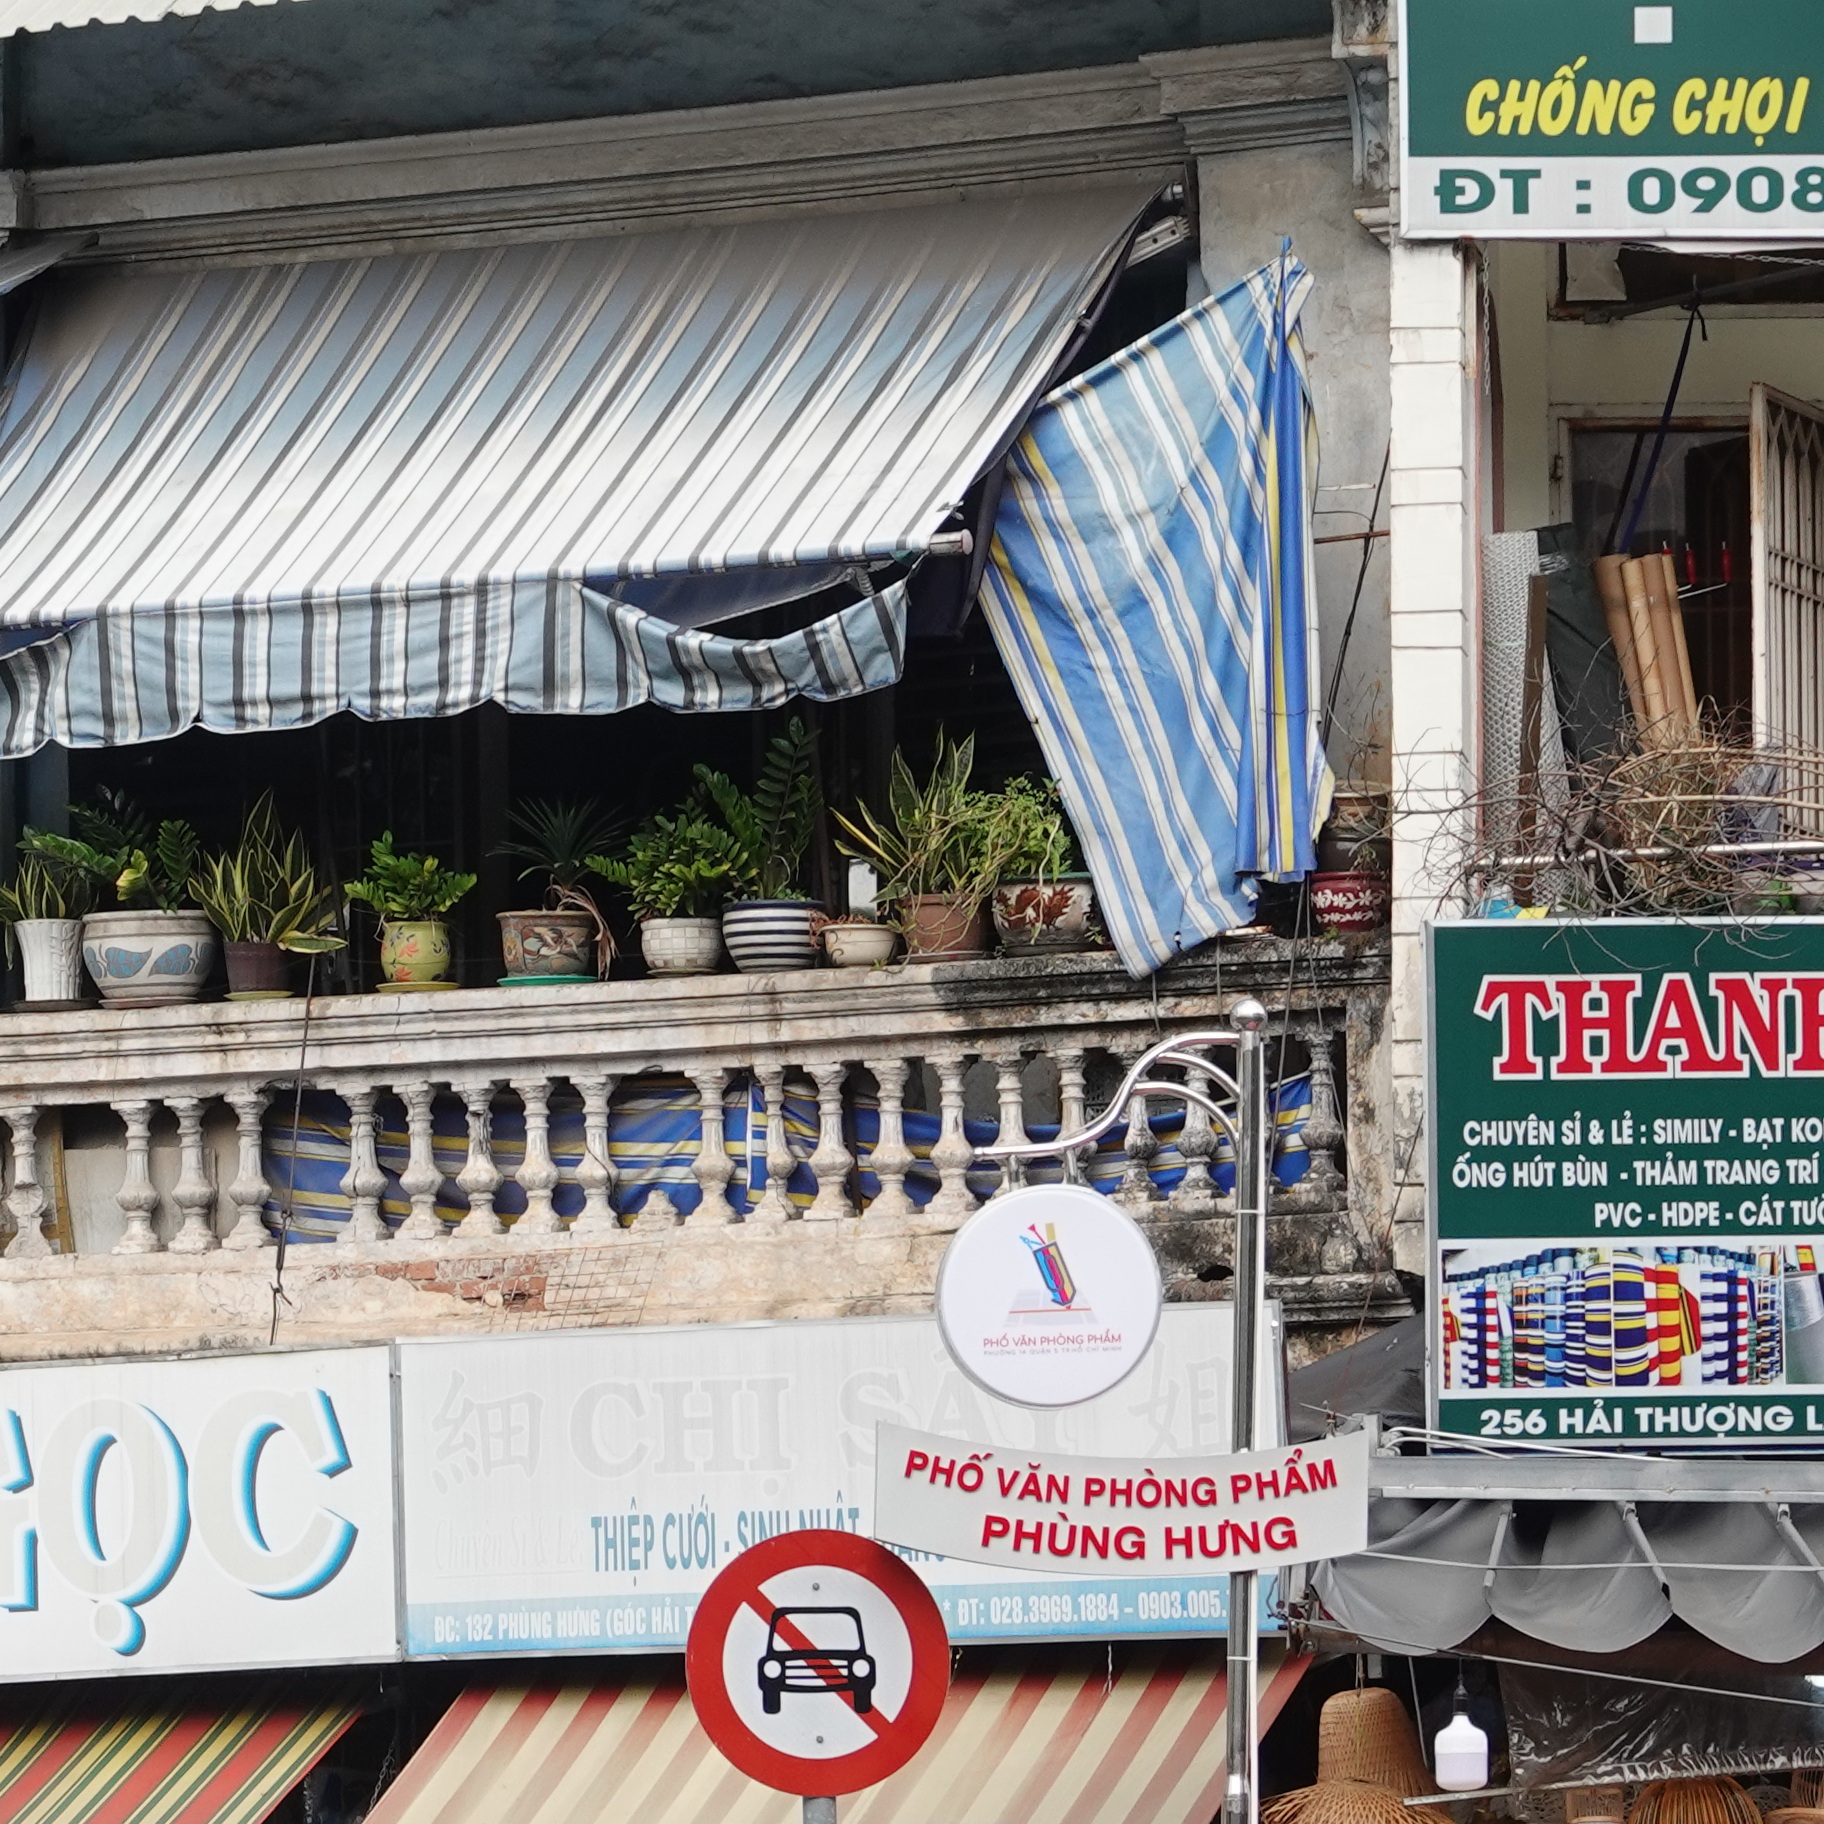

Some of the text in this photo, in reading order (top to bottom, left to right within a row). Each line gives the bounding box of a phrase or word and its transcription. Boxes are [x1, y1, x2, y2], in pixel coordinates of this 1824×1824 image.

[1465, 55, 1811, 147] CHỐNG CHỌI
[1463, 1114, 1784, 1151] CHUYÊN SIMILY BẠT
[1453, 1151, 1819, 1188] ỐNG HÚT BÙN THẢM TRANG TRÍ
[1595, 1193, 1785, 1227] PVC HDPE CÁT
[983, 1327, 1122, 1348] PHỐ VĂN PHÒNG PHẨM
[1481, 1398, 1799, 1439] 256 HẢI THƯỢNG
[905, 1448, 1338, 1508] PHỐ VĂN PHÒNG PHẨM
[980, 1512, 1146, 1560] PHÙNG
[1164, 1516, 1298, 1560] HƯNG
[465, 1594, 1119, 1642] 132 PHÙNG HƯNG 028.3969.1884
